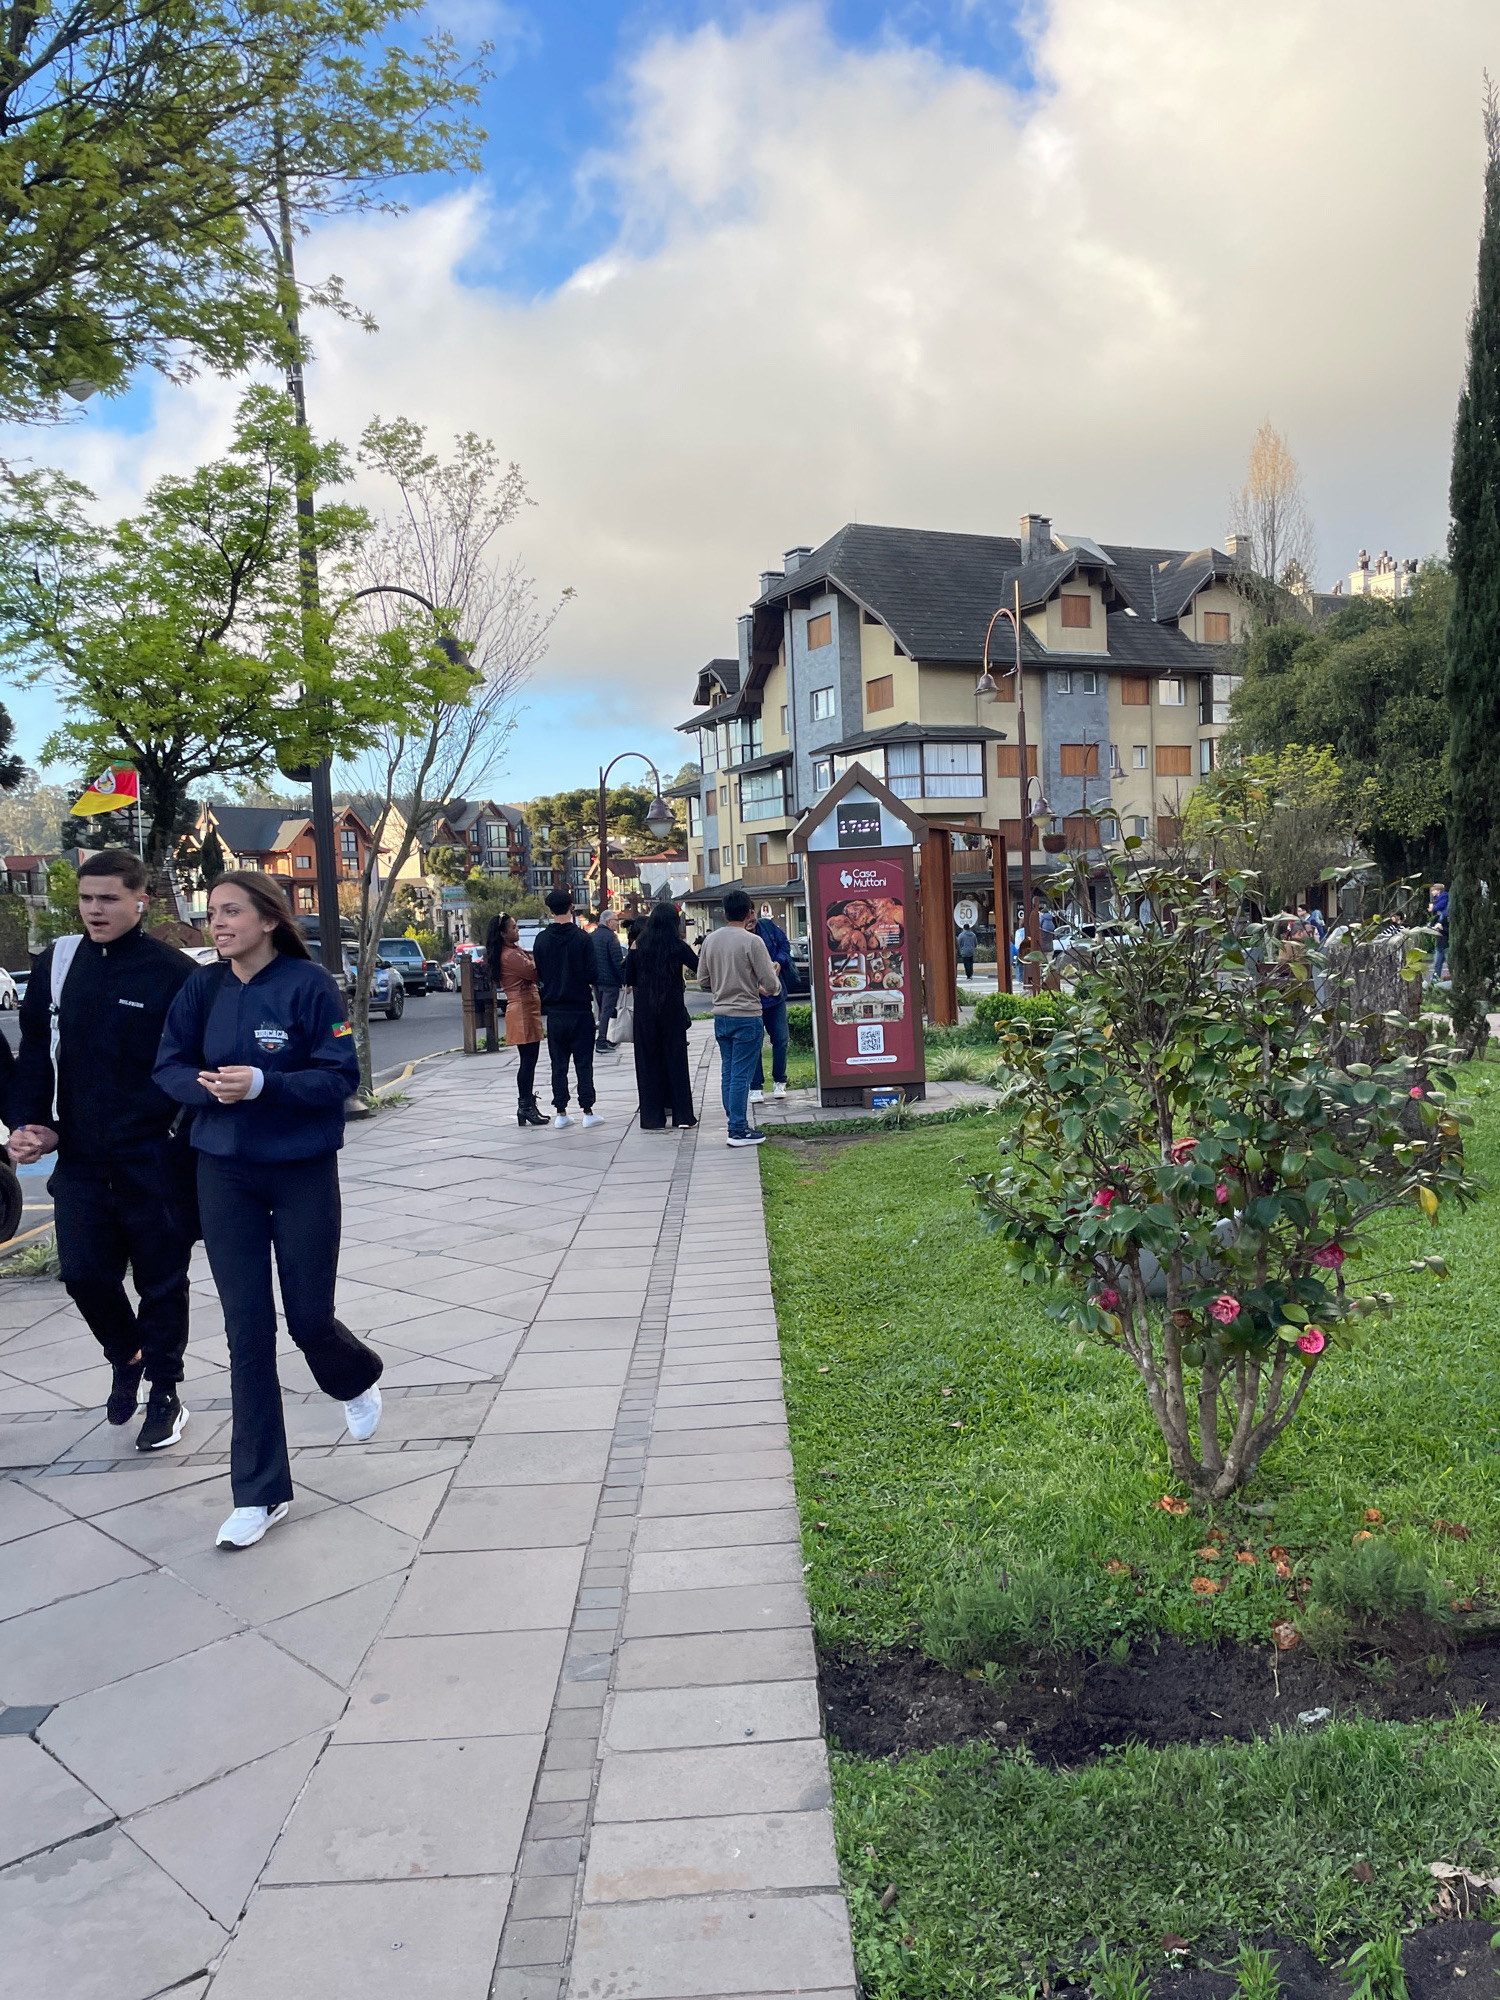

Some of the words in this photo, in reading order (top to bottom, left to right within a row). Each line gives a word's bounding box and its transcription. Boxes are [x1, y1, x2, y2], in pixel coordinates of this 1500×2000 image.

[852, 868, 877, 879] Casa
[853, 877, 887, 888] Muttoni
[959, 908, 973, 920] 50
